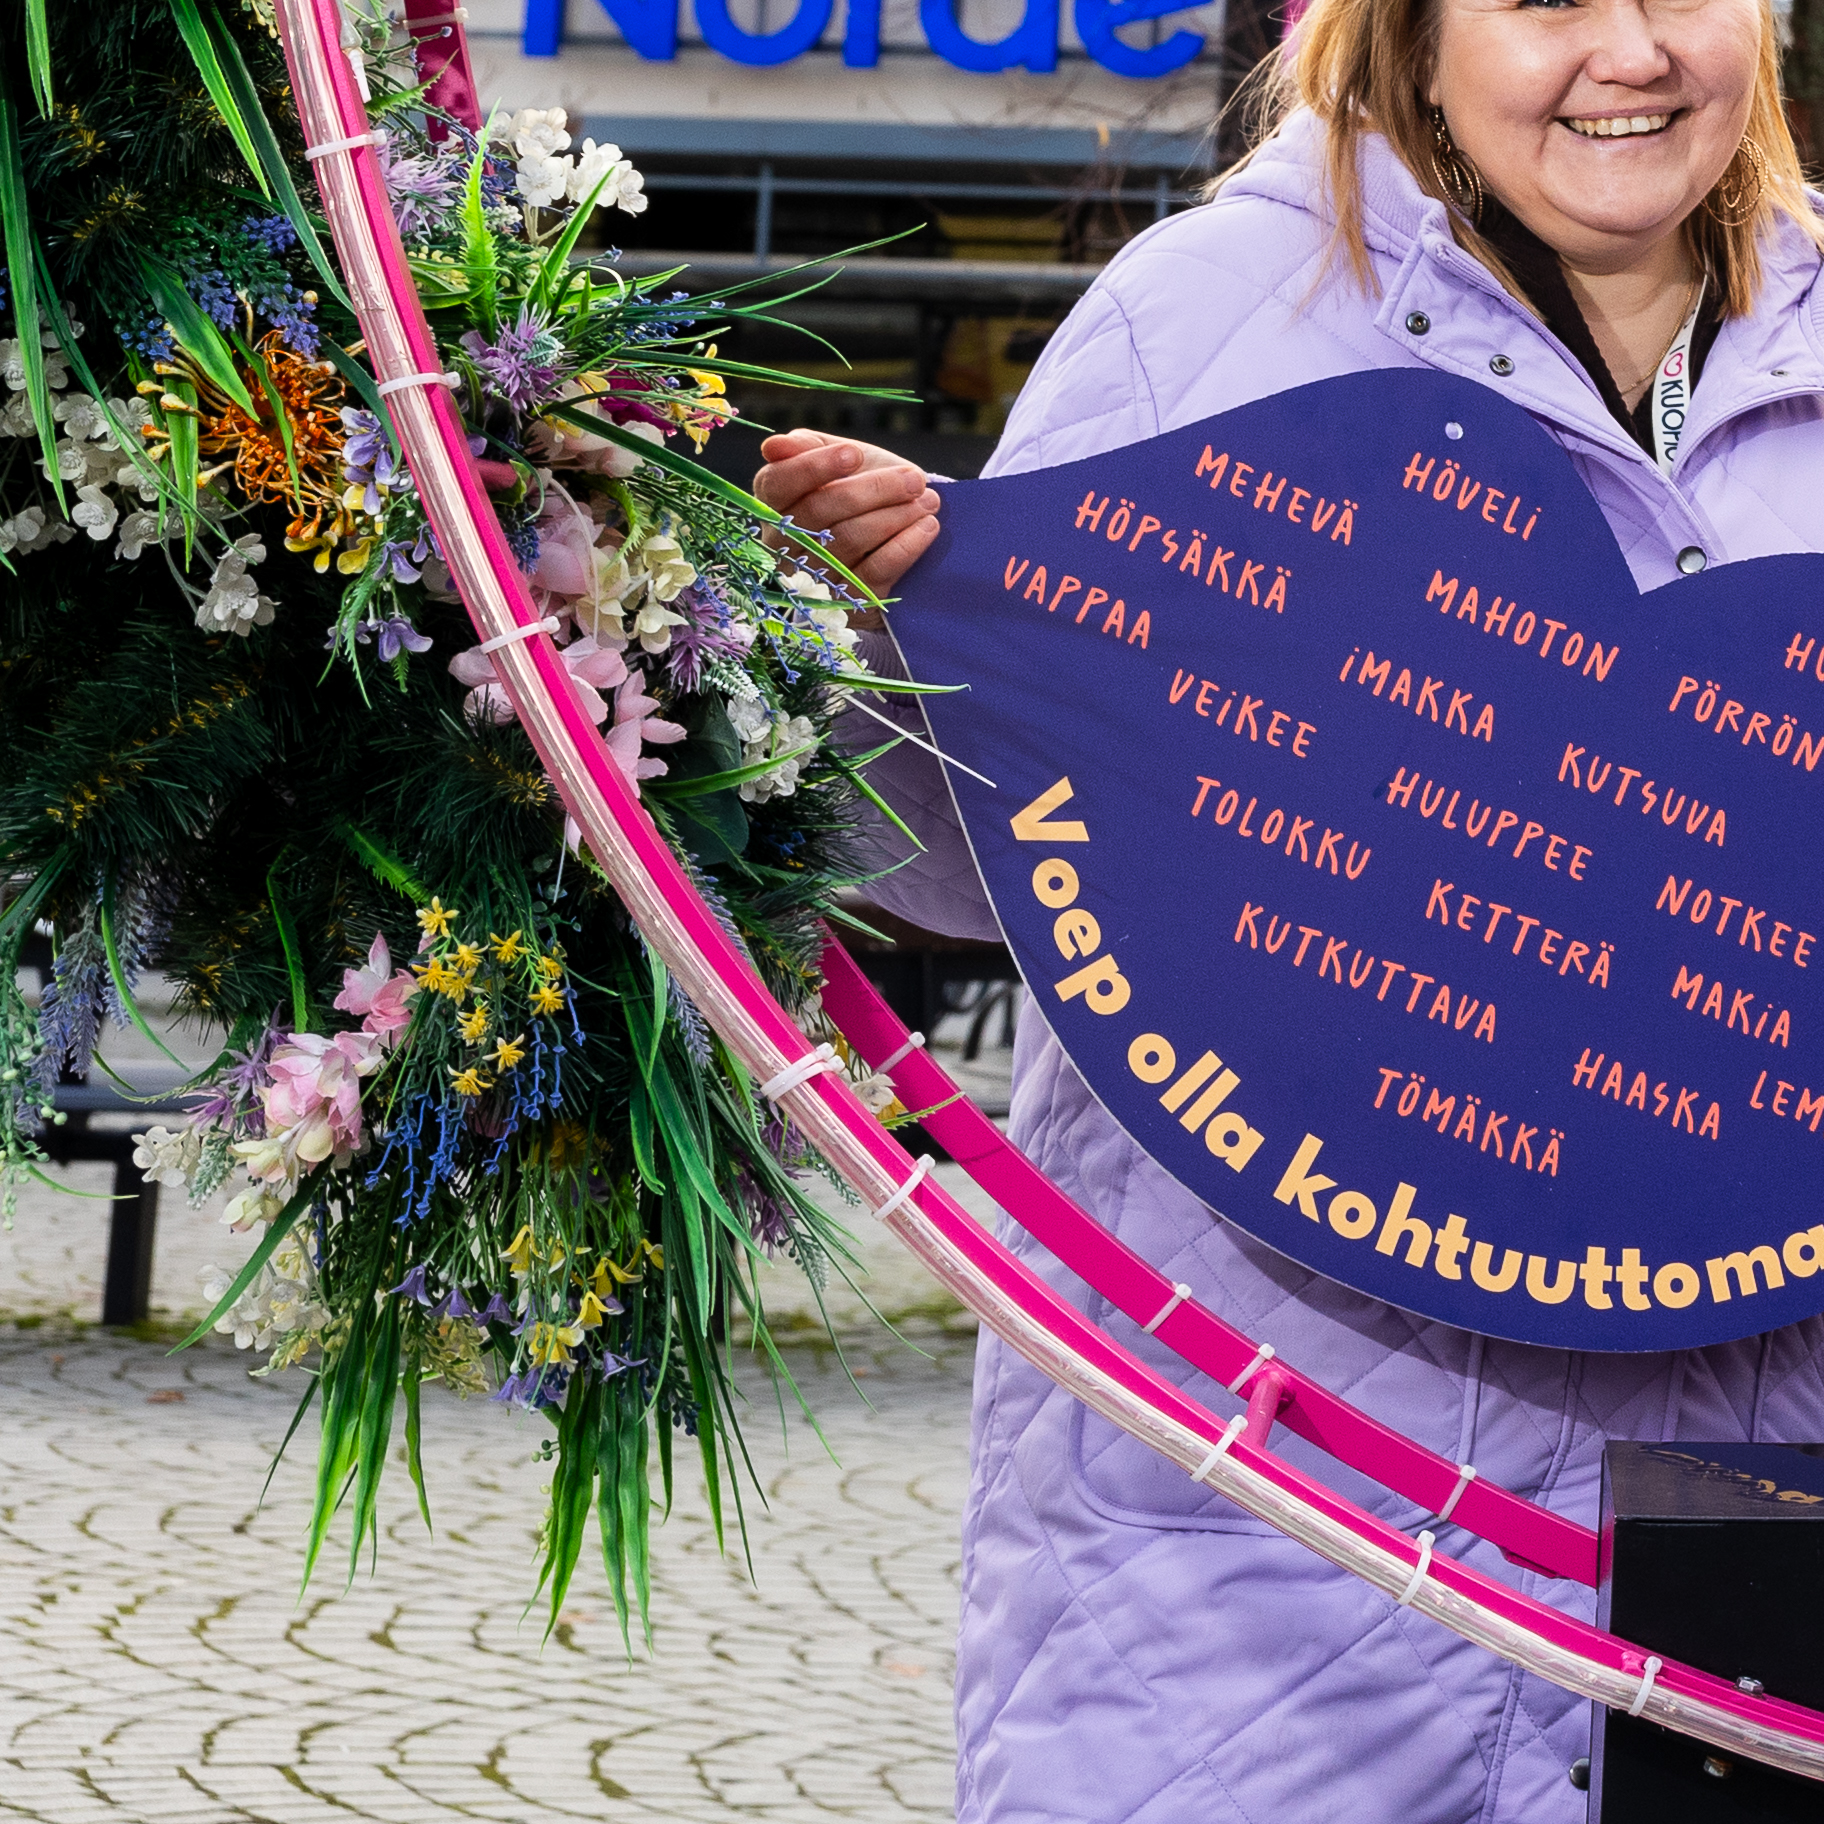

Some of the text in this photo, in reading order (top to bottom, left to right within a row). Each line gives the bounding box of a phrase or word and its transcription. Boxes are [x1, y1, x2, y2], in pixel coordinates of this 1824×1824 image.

[1195, 444, 1359, 546] MEHEVÄ
[1402, 452, 1541, 540] HÖVELi
[1004, 556, 1151, 649] VAPPAA
[1074, 491, 1292, 613] HÖPSÄKKÄ
[1425, 570, 1620, 682] MAHOTON
[1169, 668, 1317, 758] VEiKEE
[1339, 647, 1494, 742] iMAKKA
[1191, 775, 1371, 880] TOLOKKU
[1386, 767, 1593, 881] HULUPPEE
[1558, 742, 1726, 847] KUTSUVA
[1234, 902, 1496, 1043] KUTKUTTAVA
[1425, 879, 1615, 988] KETTERÄ
[1656, 875, 1816, 968] NOTKEE
[1010, 777, 1131, 1015] Voep
[1127, 1033, 1264, 1173] olla
[1671, 965, 1790, 1048] MAKiA
[1374, 1067, 1565, 1177] TÖMÄKKÄ
[1572, 1047, 1720, 1140] HAASKA
